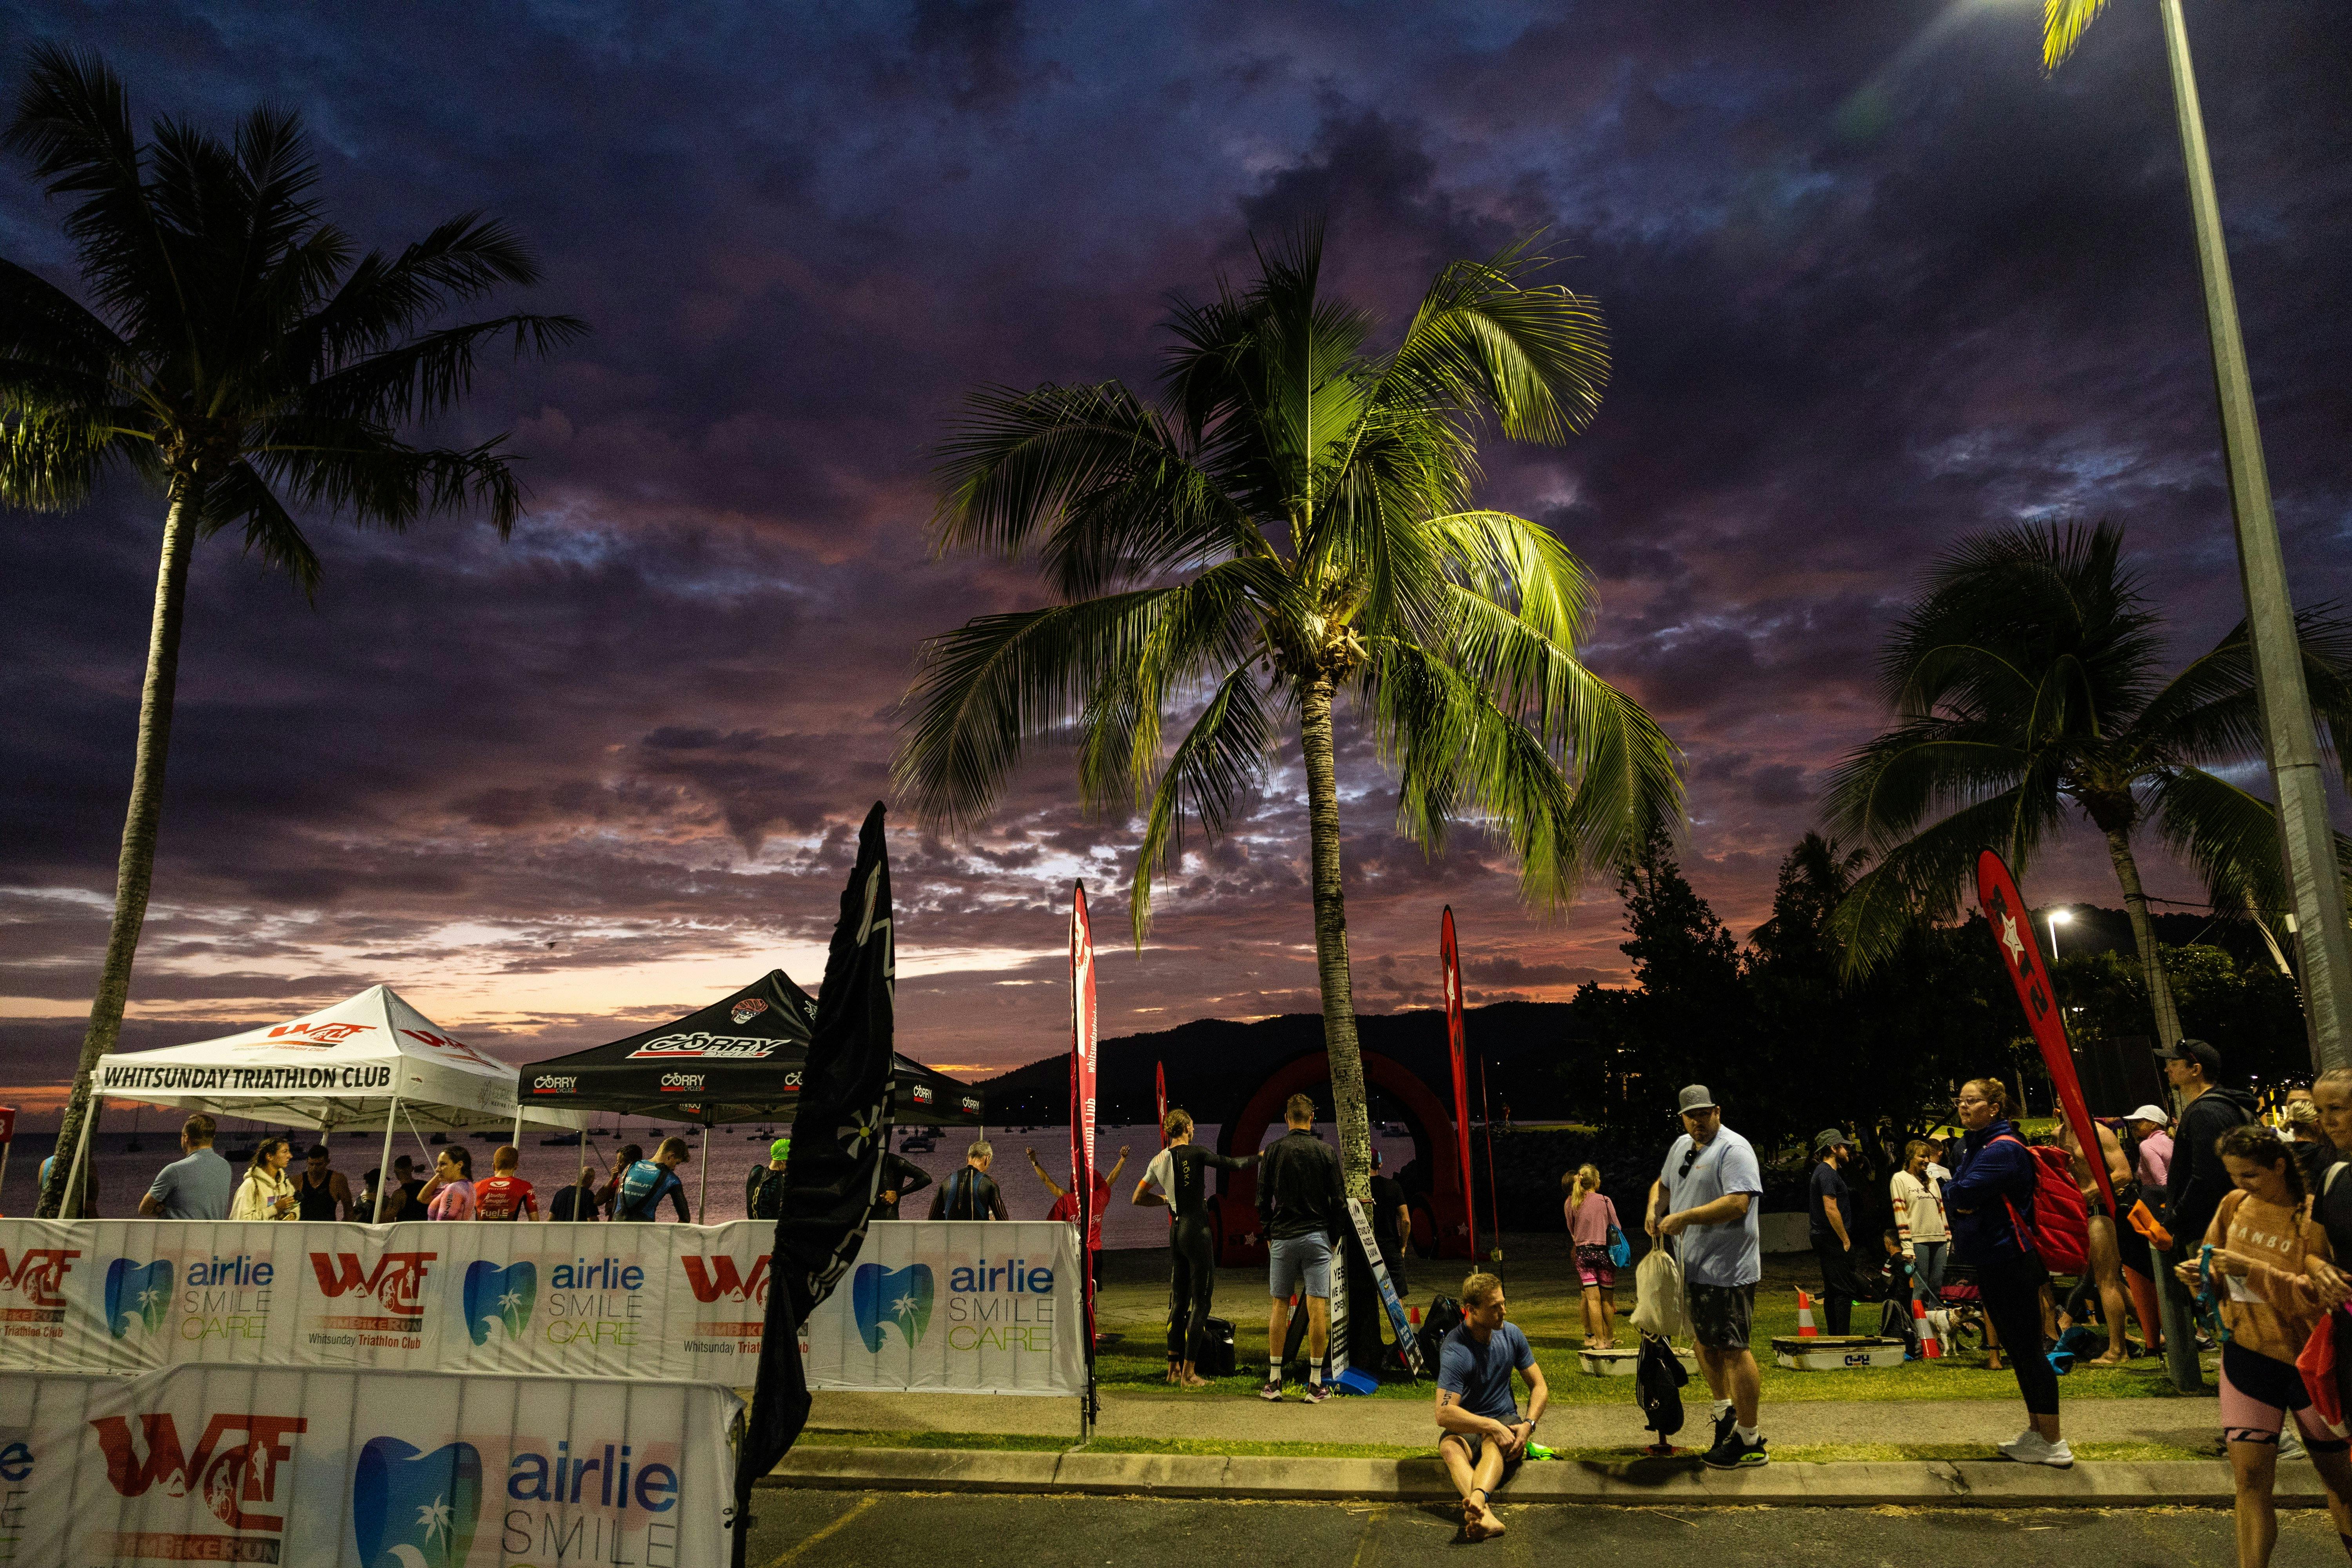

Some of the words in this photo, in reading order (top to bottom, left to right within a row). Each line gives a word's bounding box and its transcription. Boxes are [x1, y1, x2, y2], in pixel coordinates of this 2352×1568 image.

[642, 1034, 787, 1052] CORRY
[104, 1067, 230, 1089] WHITSUNDAY
[232, 1067, 337, 1089] TRIATHLON
[342, 1066, 391, 1088] CLUB
[534, 1075, 577, 1089] CORRY
[661, 1072, 705, 1087] CORRY
[187, 1255, 274, 1287] airlie
[552, 1258, 644, 1290] airlie
[950, 1258, 1055, 1293] airlie
[1334, 1266, 1345, 1281] YES
[183, 1290, 271, 1313] SMILE
[1332, 1287, 1338, 1298] WE
[548, 1293, 642, 1319] SMILE
[948, 1296, 1053, 1322] SMILE
[4, 1325, 41, 1337] Triathlon
[43, 1327, 64, 1338] Club
[181, 1316, 267, 1340] CARE
[547, 1320, 640, 1346] CARE
[948, 1325, 1053, 1352] CARE
[309, 1333, 356, 1347] Whitsunday
[359, 1334, 399, 1348] Triathlon
[401, 1336, 421, 1349] Club
[684, 1340, 735, 1356] Whitsunday
[737, 1341, 761, 1354] Triat
[507, 1441, 678, 1512] airlie
[502, 1509, 675, 1568] SMILE
